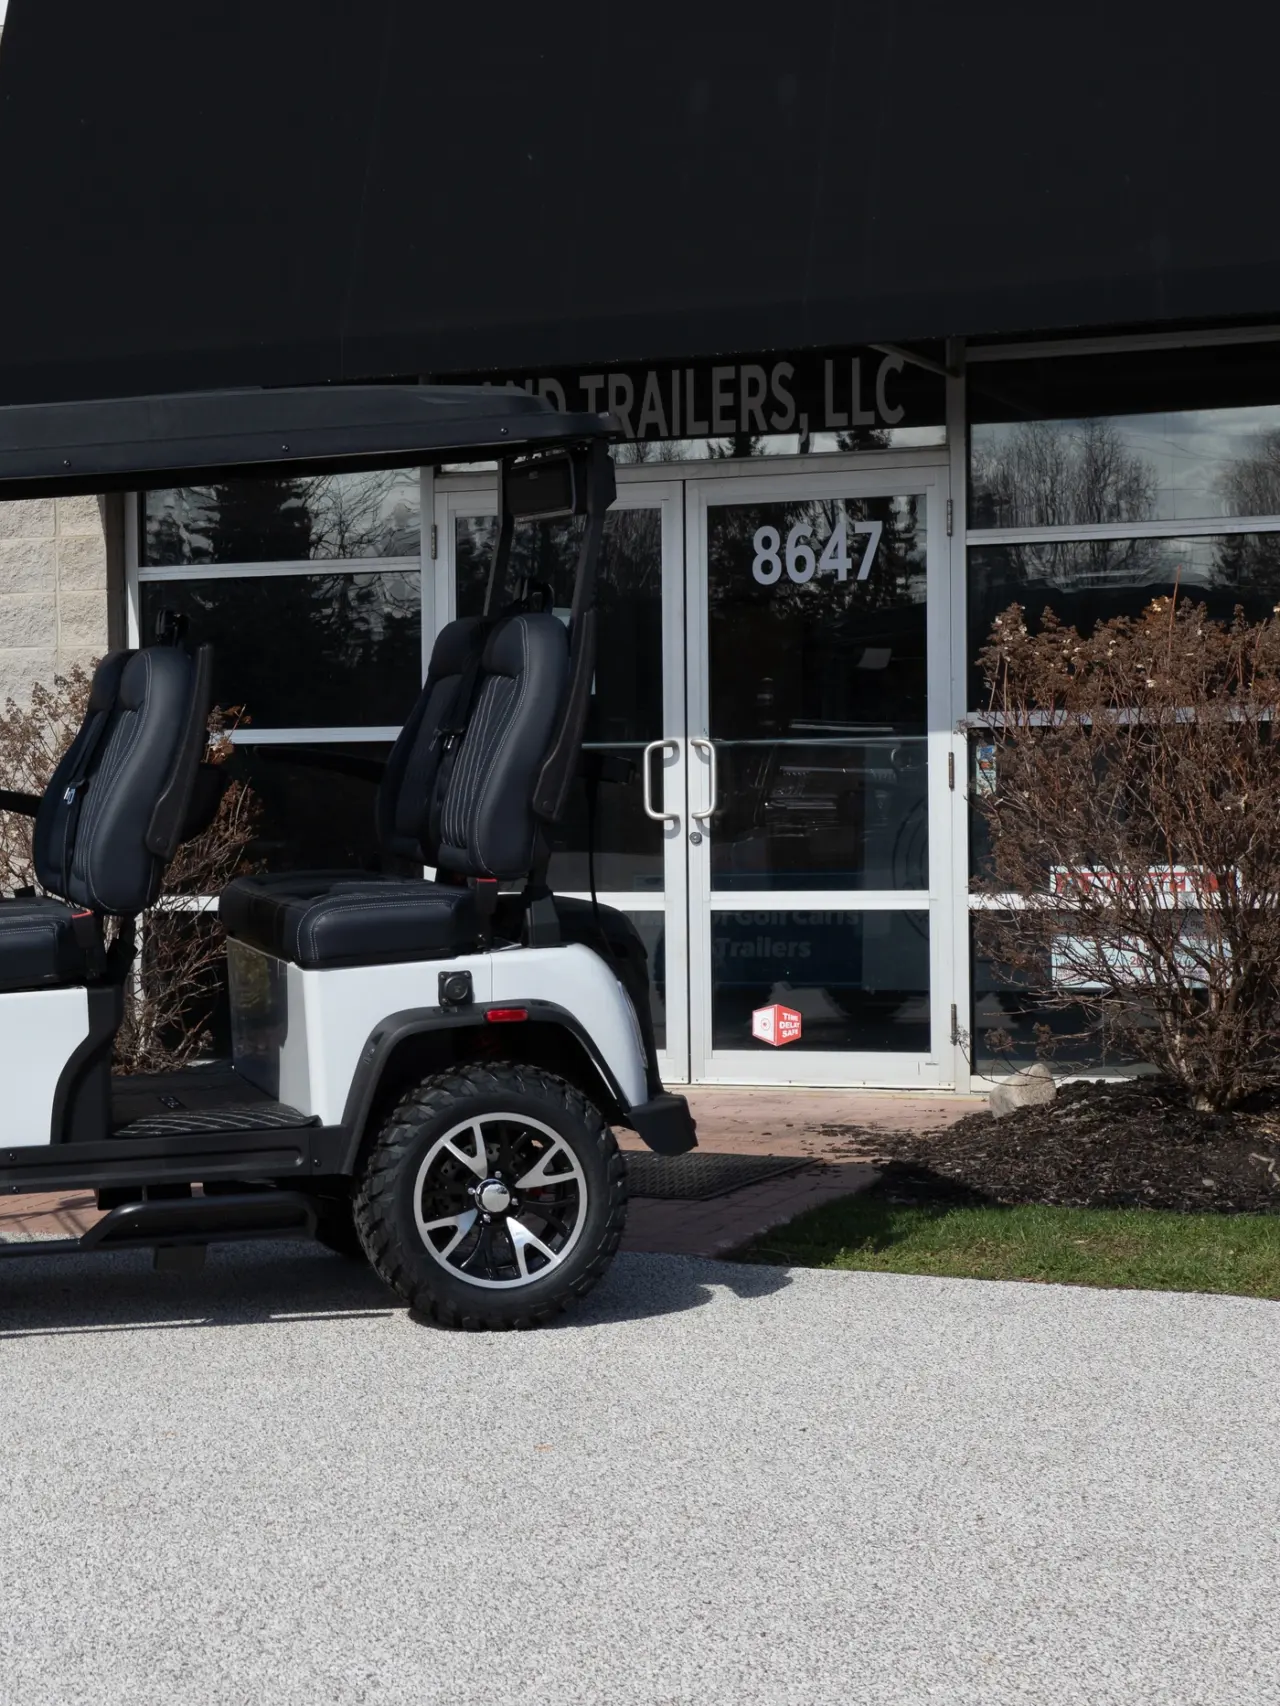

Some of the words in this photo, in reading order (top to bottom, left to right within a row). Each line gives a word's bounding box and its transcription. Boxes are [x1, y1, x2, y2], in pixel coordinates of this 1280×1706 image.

[579, 362, 810, 442] TRAILERS,
[824, 354, 905, 427] LLC
[752, 520, 883, 586] 8647
[716, 935, 812, 958] Trailers
[782, 1012, 799, 1021] TIME
[779, 1021, 800, 1029] DELAY
[782, 1029, 799, 1038] SAFE
